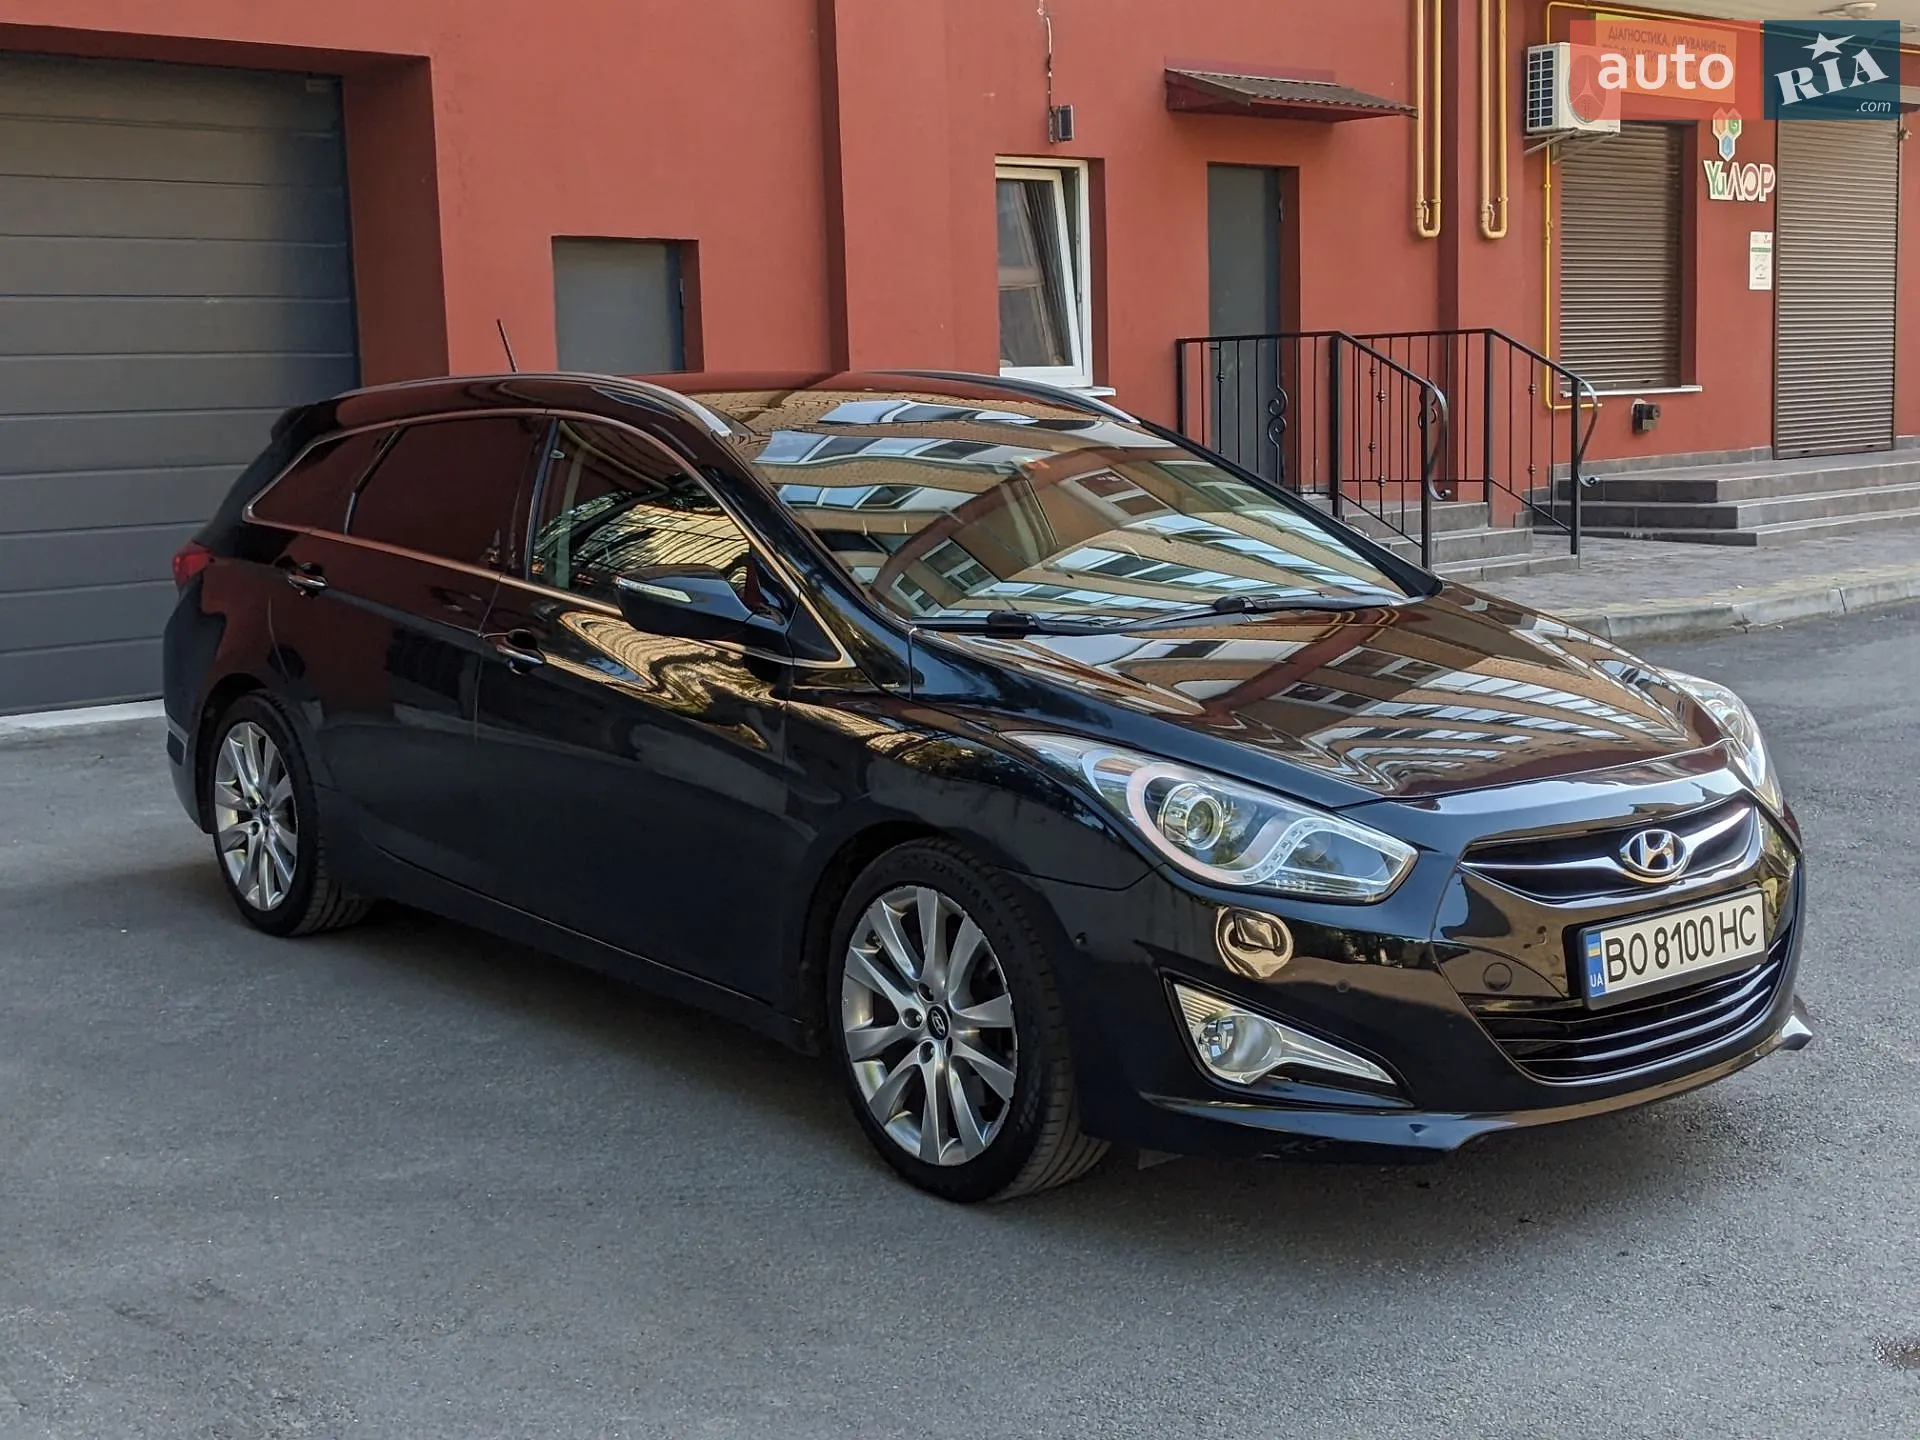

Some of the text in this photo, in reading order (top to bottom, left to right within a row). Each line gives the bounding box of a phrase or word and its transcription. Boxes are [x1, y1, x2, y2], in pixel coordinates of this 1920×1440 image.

[1608, 26, 1670, 48] ДІАГНОСТИКА,
[1605, 905, 1757, 983] BO 8100 HC
[1590, 974, 1604, 988] UA
